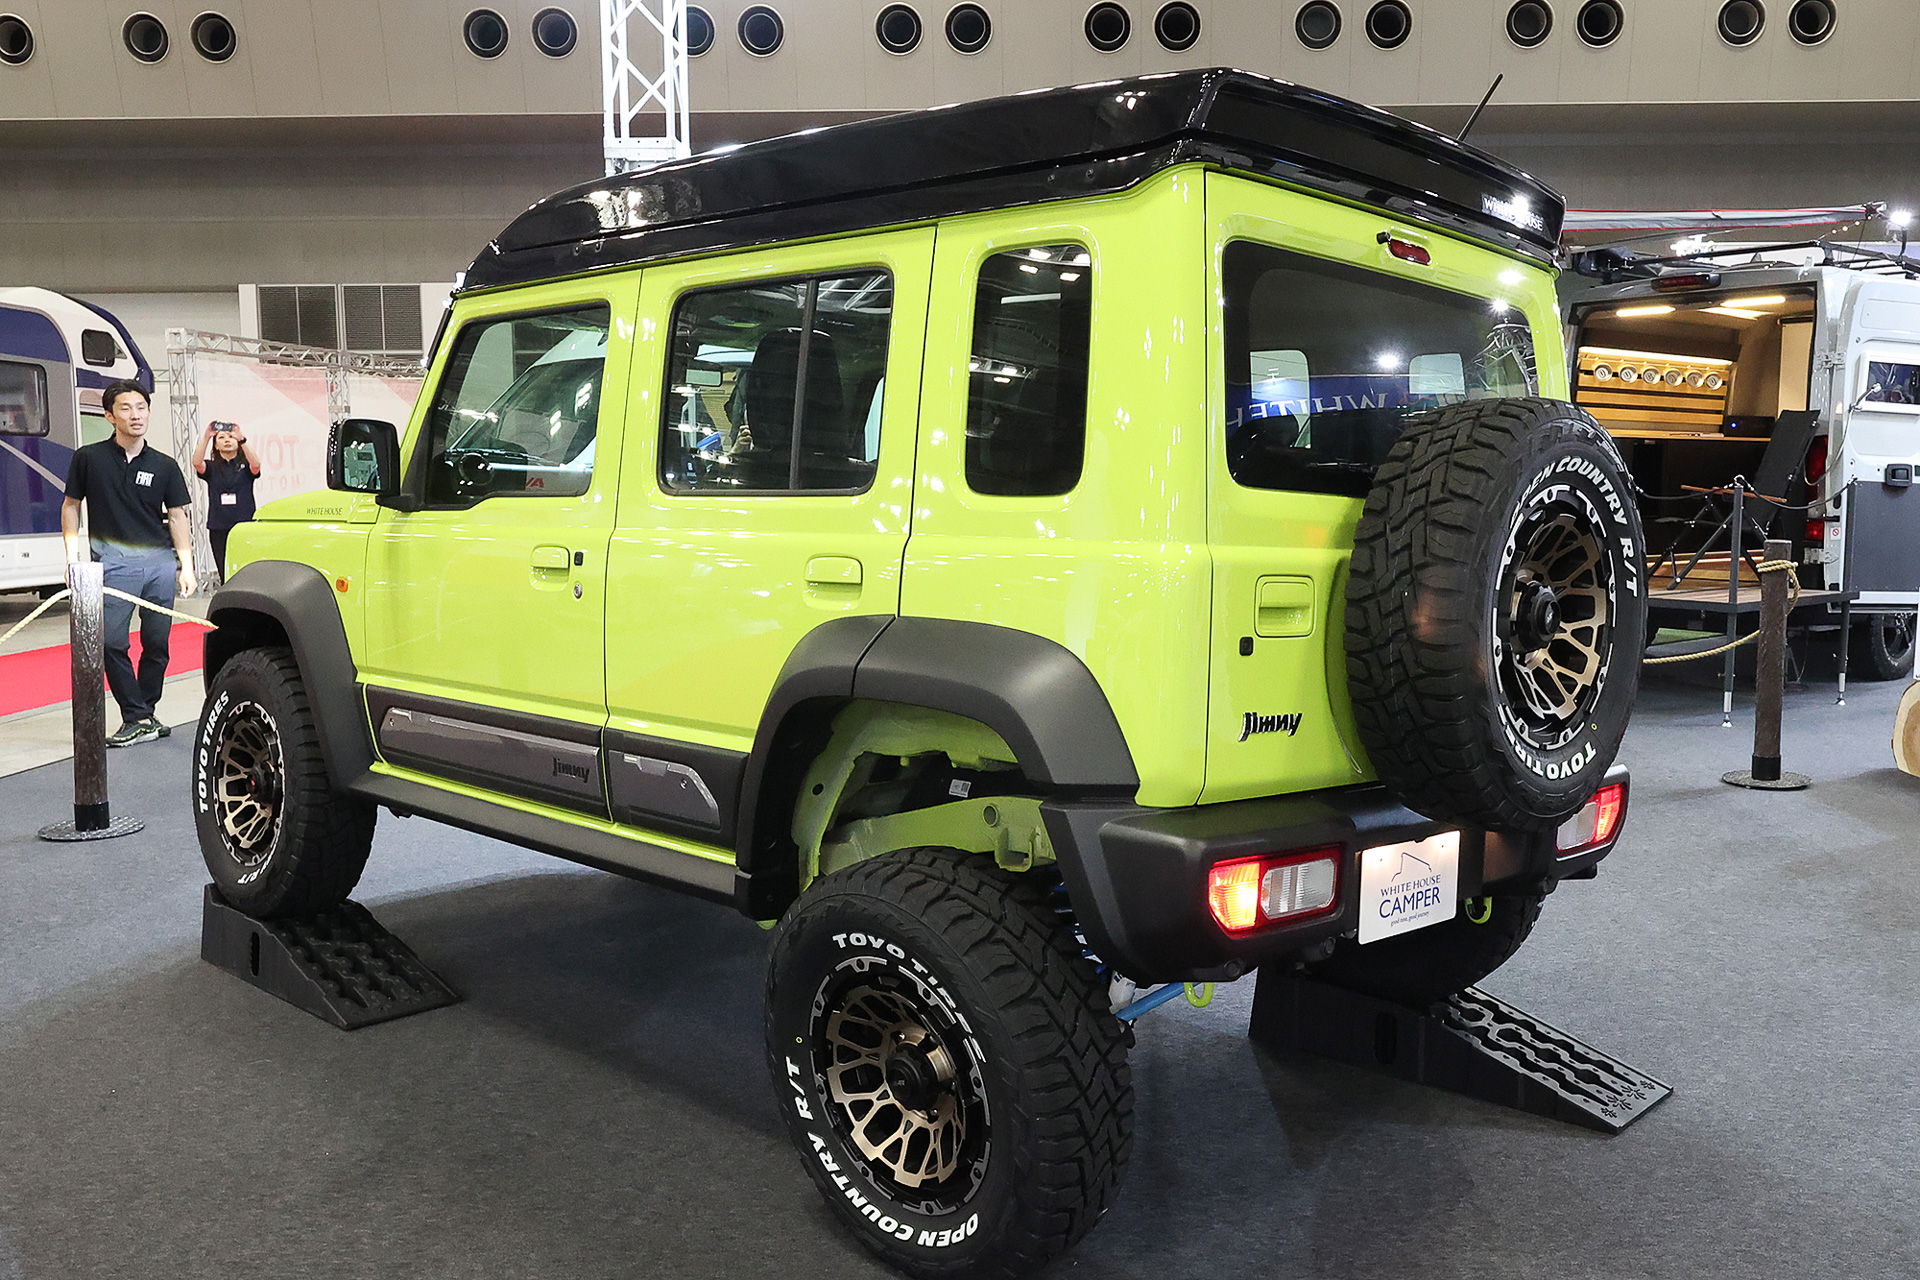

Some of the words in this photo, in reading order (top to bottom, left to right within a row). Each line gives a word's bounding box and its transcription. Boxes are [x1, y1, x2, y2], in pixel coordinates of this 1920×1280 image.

[135, 470, 154, 487] FIAT
[306, 507, 324, 516] WHITE
[324, 507, 343, 516] HOUSE
[1555, 455, 1628, 526] COUNTRY
[1619, 537, 1638, 598] R/T
[202, 690, 230, 747] TIRES
[1237, 711, 1303, 742] Jimny
[552, 757, 590, 784] Jimny
[1546, 741, 1597, 780] TOYO
[198, 748, 209, 814] TOYO
[1379, 886, 1441, 919] CAMPER
[1380, 881, 1412, 897] WHITE
[1413, 874, 1441, 890] HOUSE
[832, 932, 905, 960] TOYO
[785, 1056, 814, 1121] R/T
[807, 1131, 914, 1241] COUNTRY
[917, 1212, 979, 1248] OPEN
